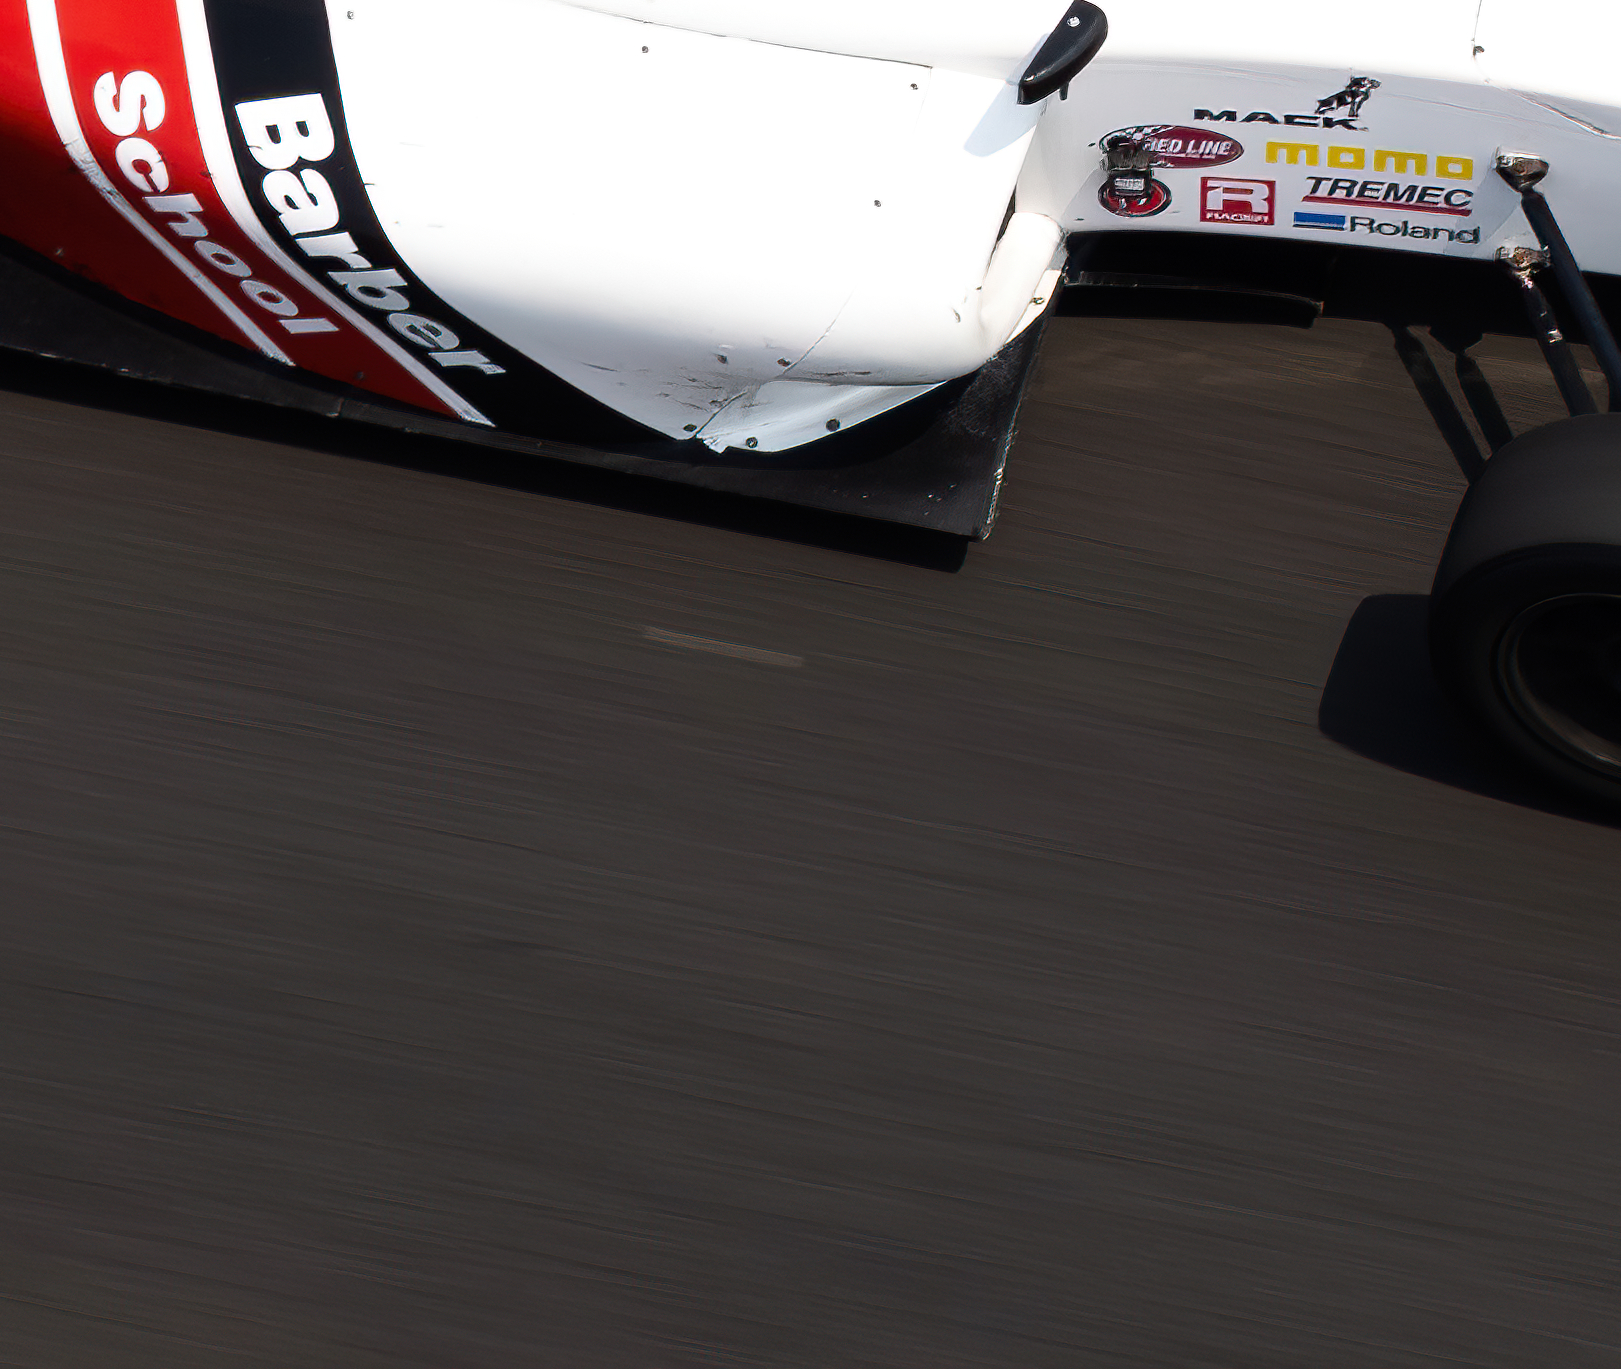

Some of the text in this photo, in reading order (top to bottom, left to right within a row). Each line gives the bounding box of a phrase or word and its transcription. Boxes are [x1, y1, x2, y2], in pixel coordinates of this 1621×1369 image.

[1193, 108, 1368, 132] MACK
[1186, 138, 1234, 156] LINE
[93, 69, 341, 335] School
[1305, 176, 1474, 209] TREMEC
[234, 92, 507, 376] Barber
[1349, 216, 1481, 245] Roland
